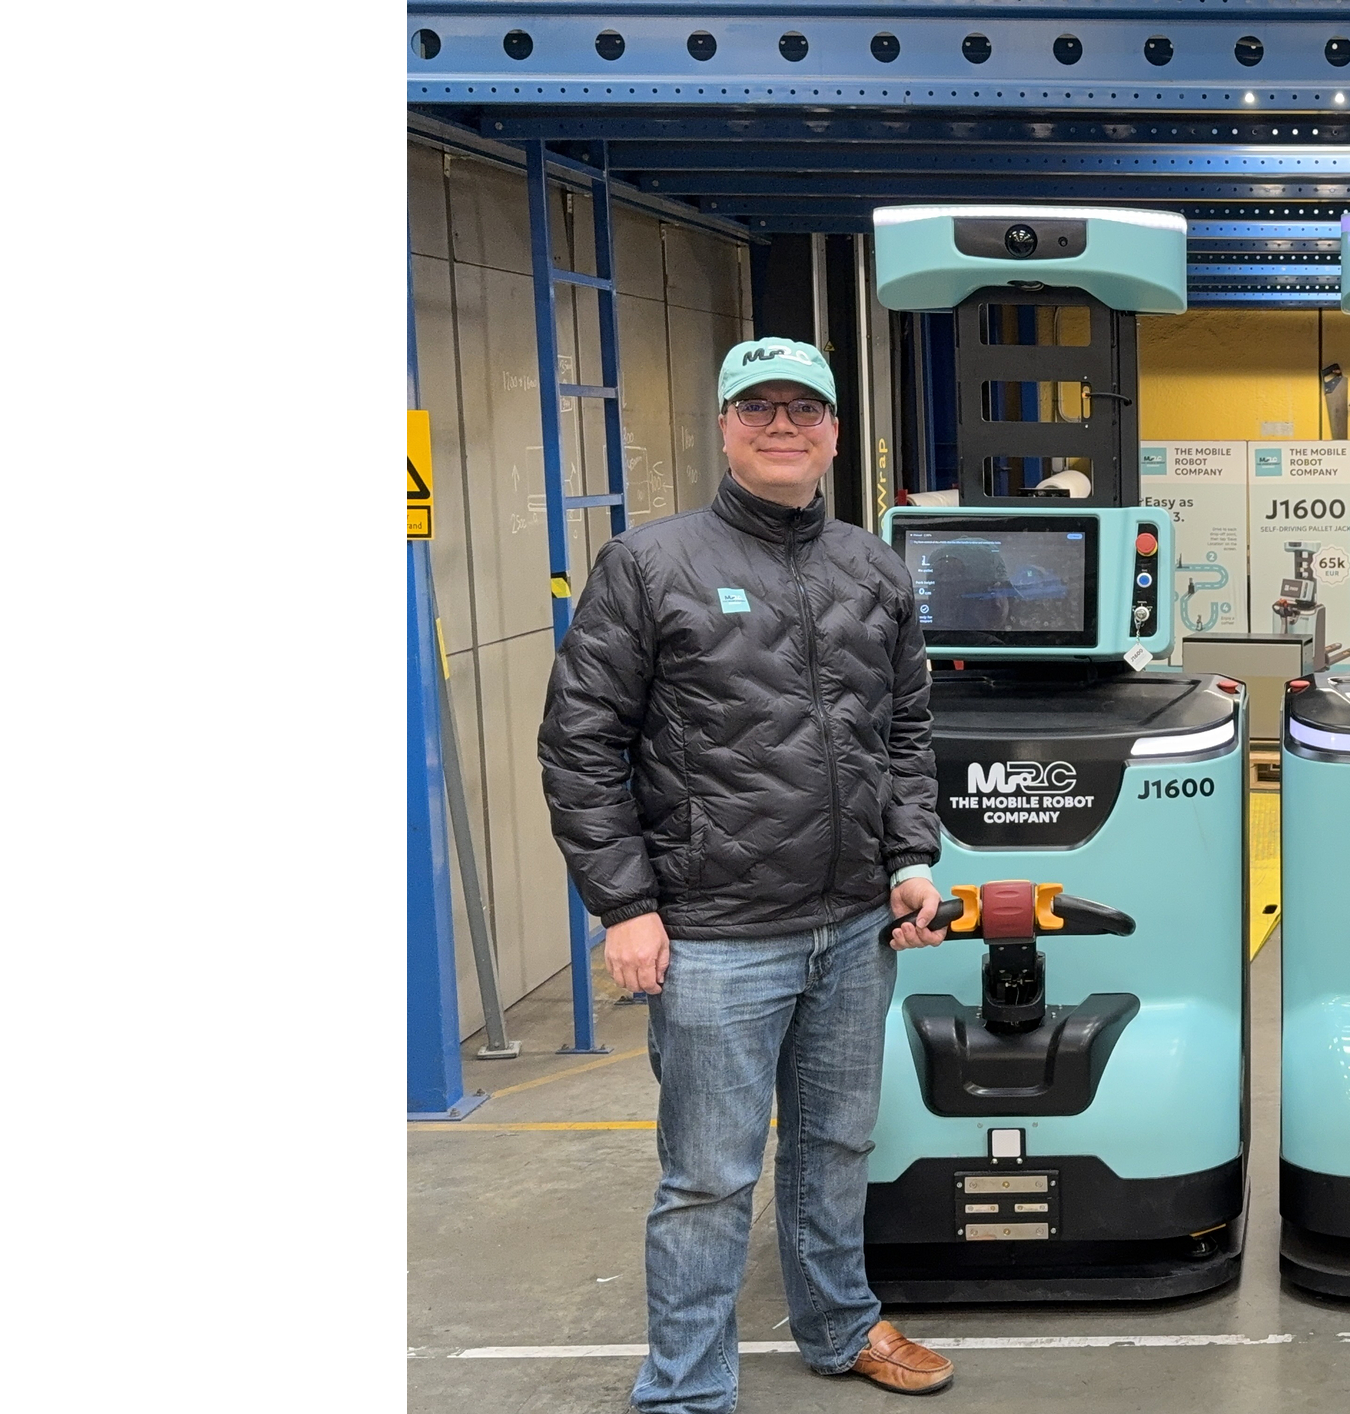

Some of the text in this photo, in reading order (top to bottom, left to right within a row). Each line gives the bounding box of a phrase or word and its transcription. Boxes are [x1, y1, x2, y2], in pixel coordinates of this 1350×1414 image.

[1174, 447, 1232, 456] THE MOBILE
[1289, 448, 1347, 456] THE MOBILE
[1174, 458, 1208, 466] ROBOT
[1290, 458, 1322, 466] ROBOT
[1174, 468, 1223, 476] COMPANY
[1290, 468, 1338, 477] COMPANY
[1179, 499, 1194, 507] as
[1265, 498, 1346, 520] J1600
[1173, 511, 1185, 522] 3.
[1319, 557, 1345, 569] 65k
[1137, 777, 1215, 800] J1600
[950, 796, 1095, 809] THE MOBILE ROBOT
[983, 811, 1061, 824] COMPANY
